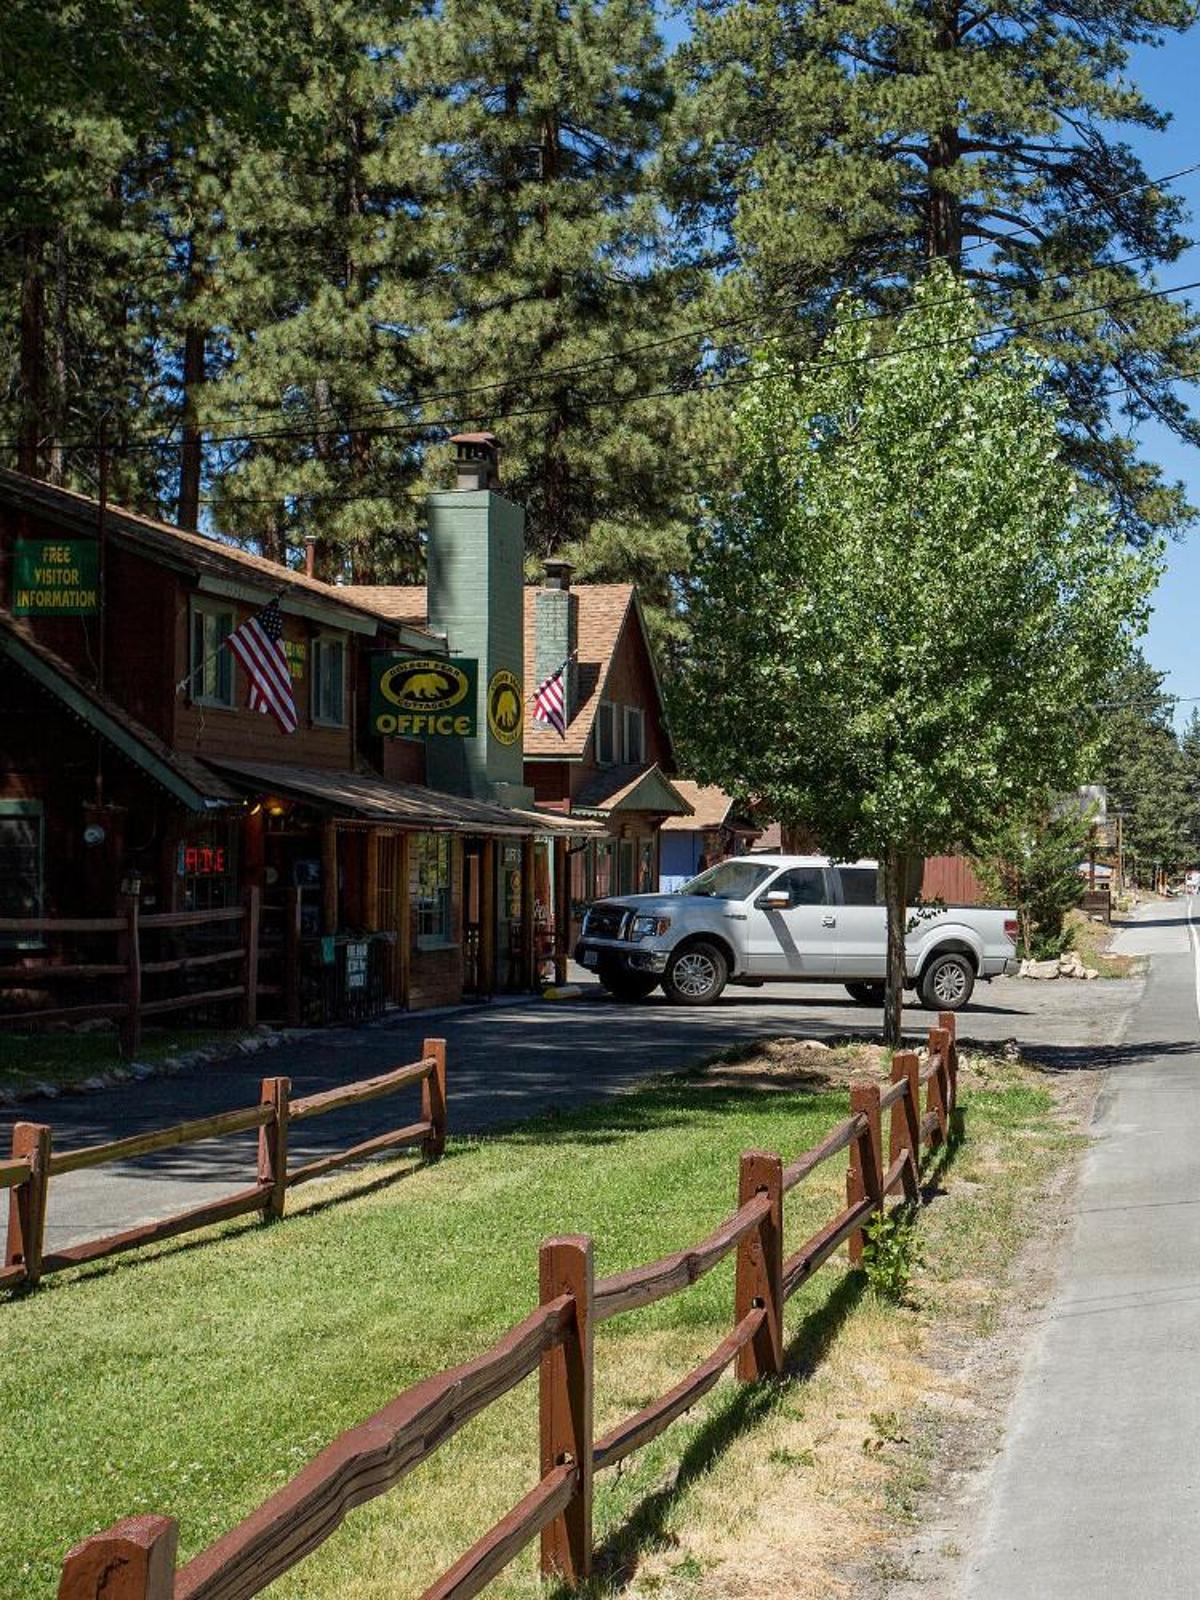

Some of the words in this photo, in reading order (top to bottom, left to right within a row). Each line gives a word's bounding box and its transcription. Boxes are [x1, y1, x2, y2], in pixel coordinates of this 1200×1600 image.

[42, 546, 72, 563] FREE
[34, 567, 80, 585] VISITOR
[17, 590, 96, 608] INFORMATION
[376, 714, 471, 735] OFFICE
